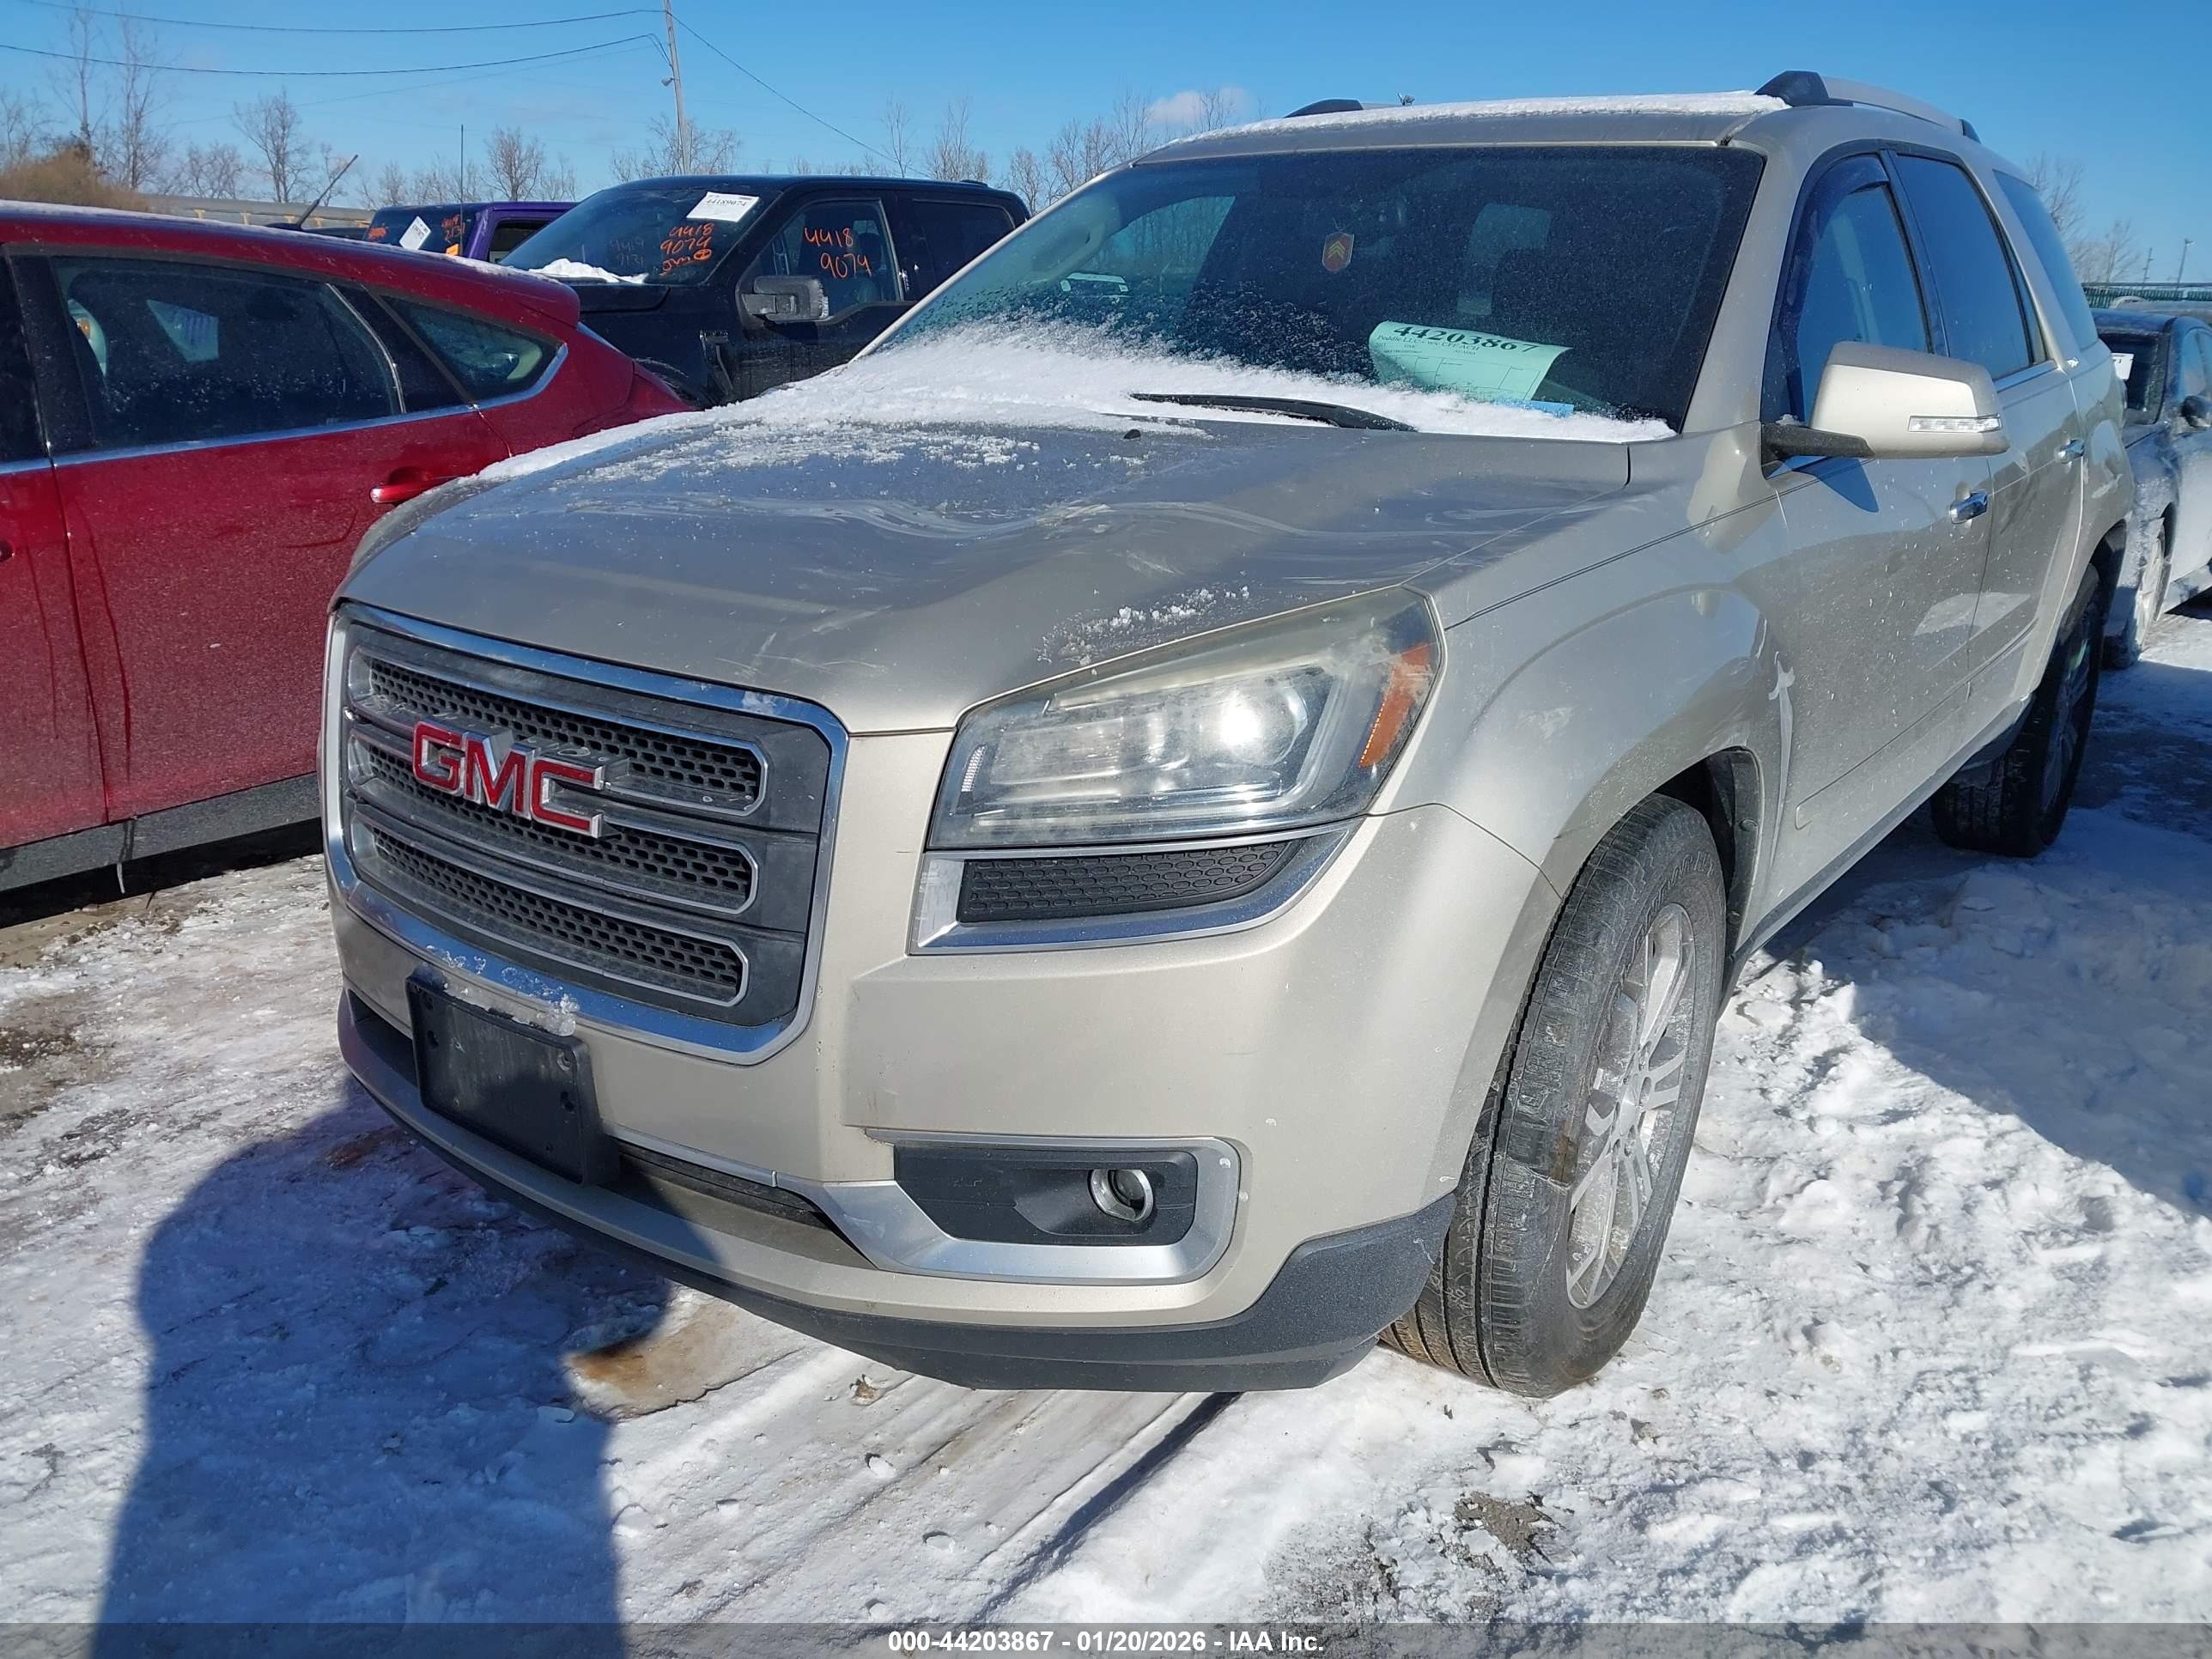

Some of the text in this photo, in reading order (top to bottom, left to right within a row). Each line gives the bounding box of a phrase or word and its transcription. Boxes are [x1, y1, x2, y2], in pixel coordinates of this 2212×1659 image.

[669, 222, 715, 238] 4418
[804, 227, 854, 248] 4418
[659, 237, 713, 255] 9074
[820, 252, 872, 279] 9074
[1394, 326, 1540, 352] 44203867
[412, 720, 605, 839] GMC
